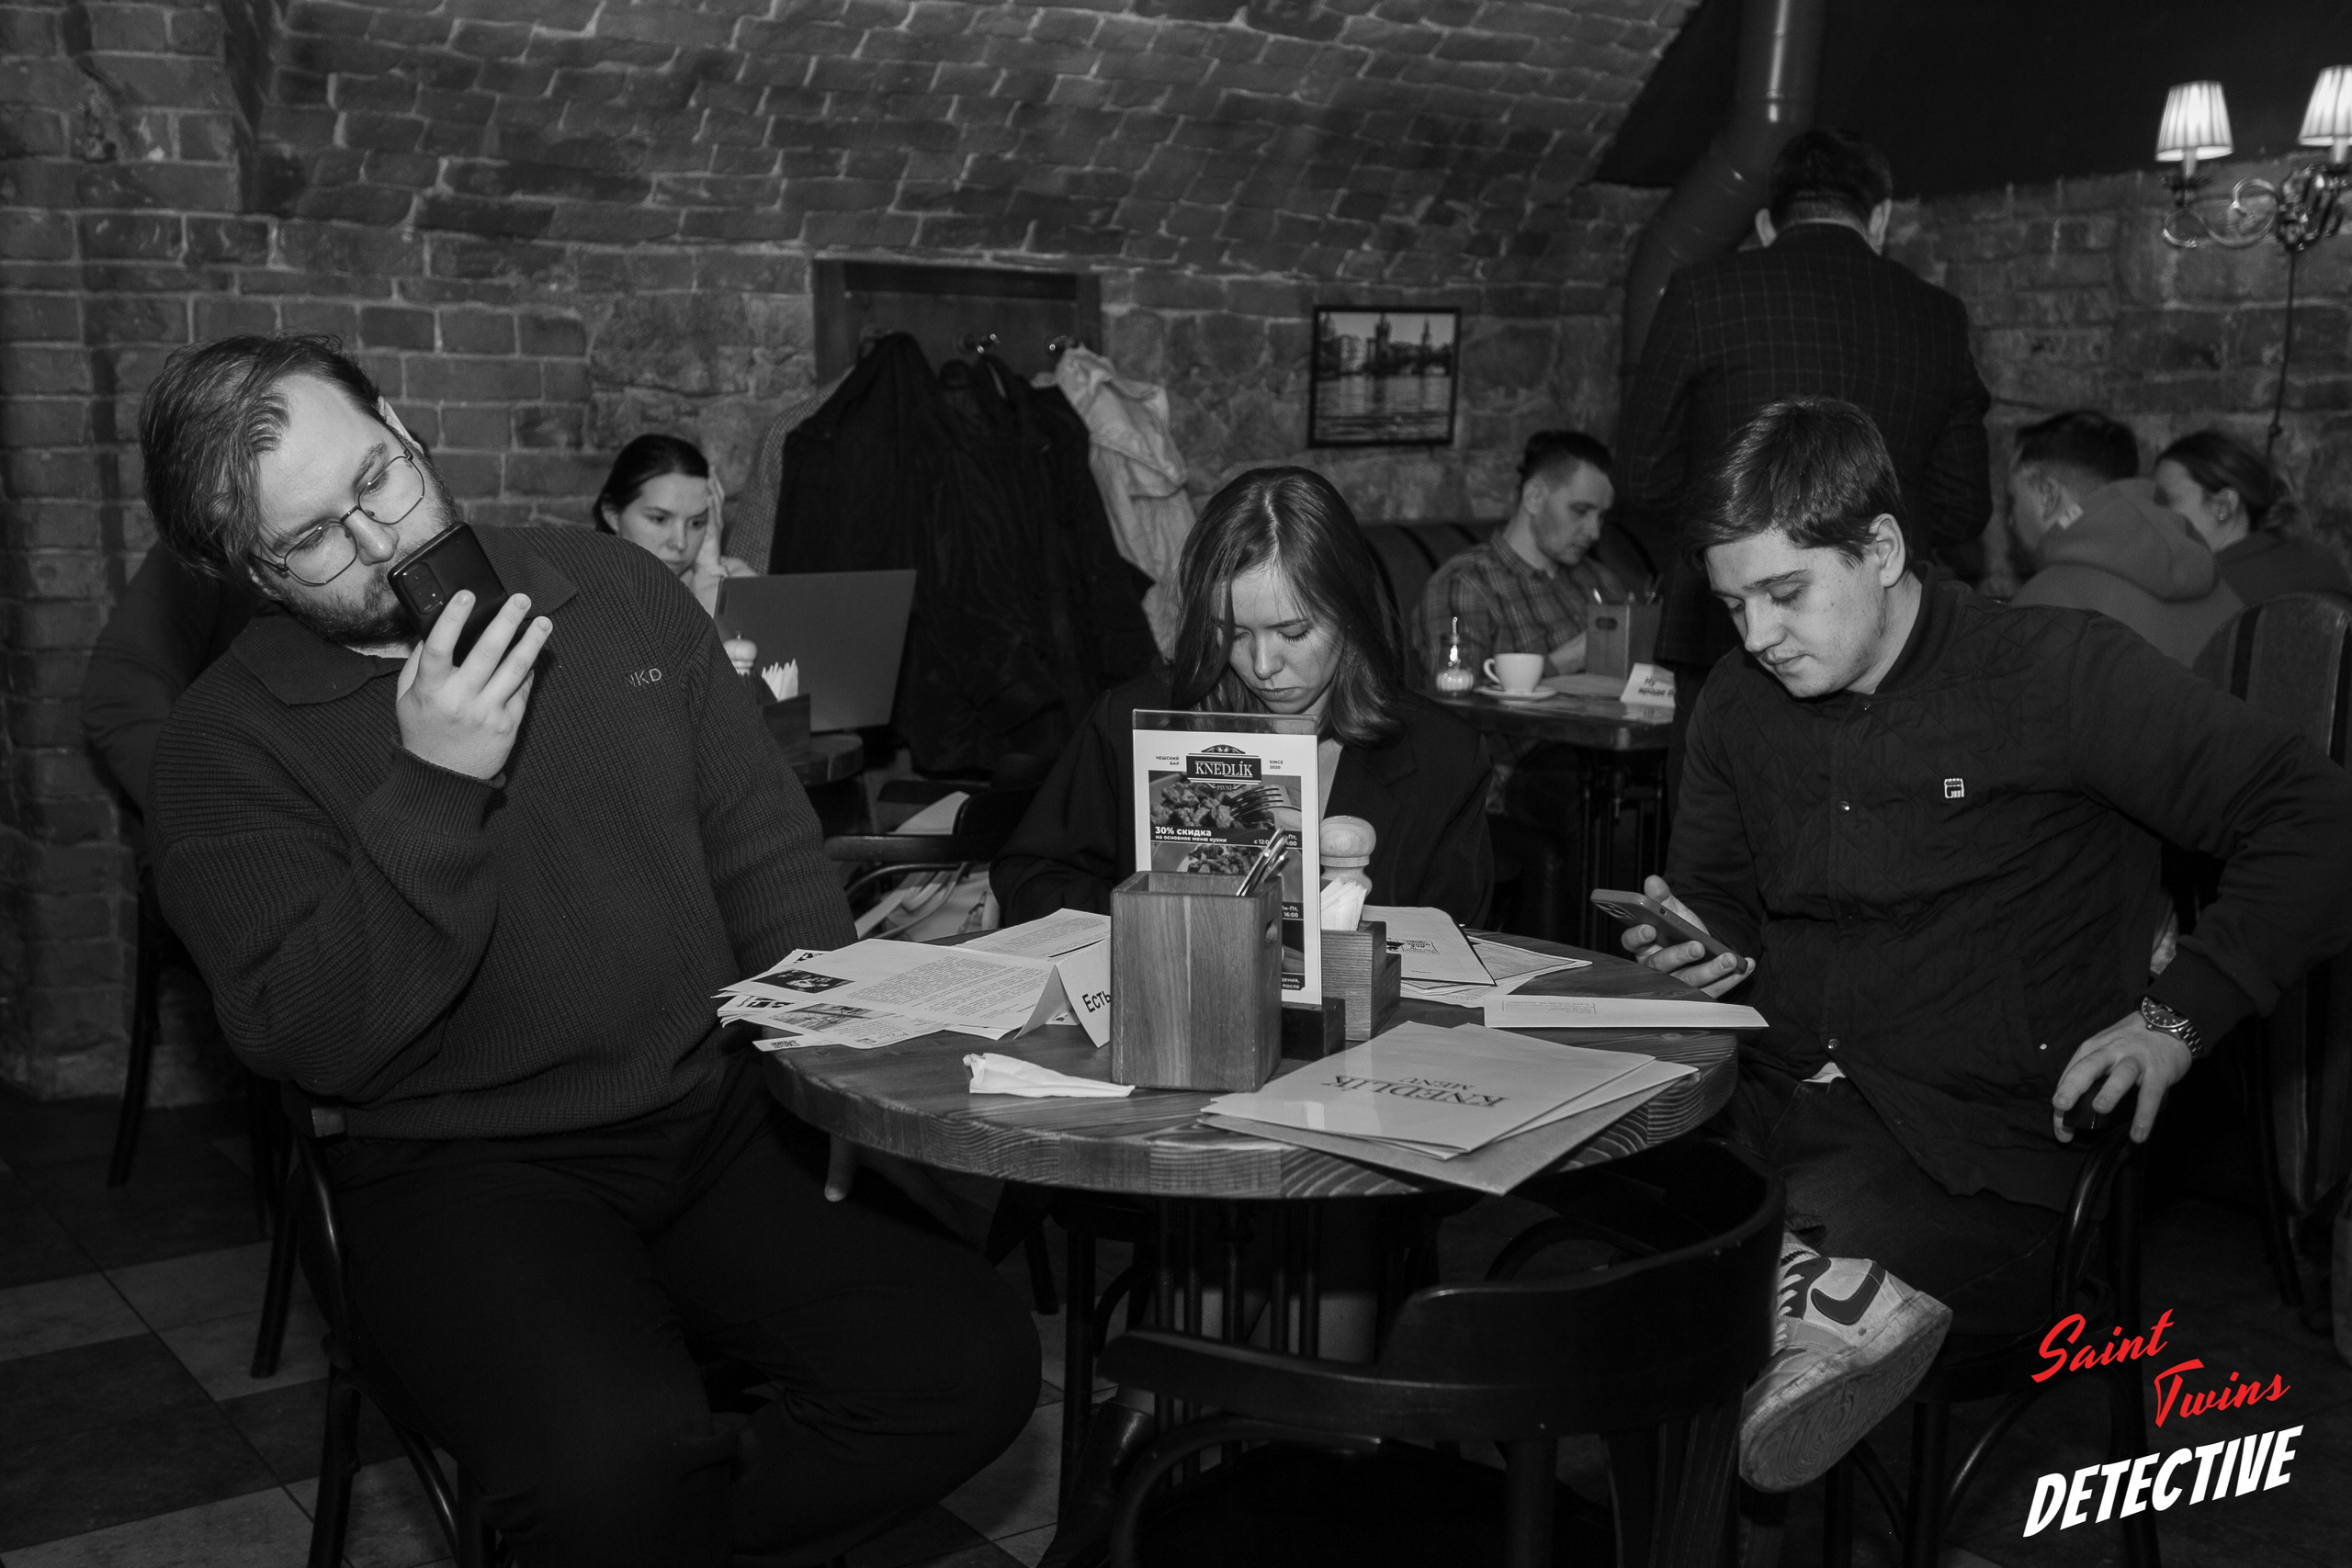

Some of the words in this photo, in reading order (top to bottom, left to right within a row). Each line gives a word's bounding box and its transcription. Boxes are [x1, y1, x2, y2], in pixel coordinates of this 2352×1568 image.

[1195, 761, 1253, 776] KNEDLÍK
[1155, 826, 1175, 835] 30%
[1176, 829, 1212, 837] скидка
[1082, 990, 1111, 1013] Есть
[1397, 1077, 1475, 1090] MENU
[1321, 1076, 1510, 1108] KNEDLÍK
